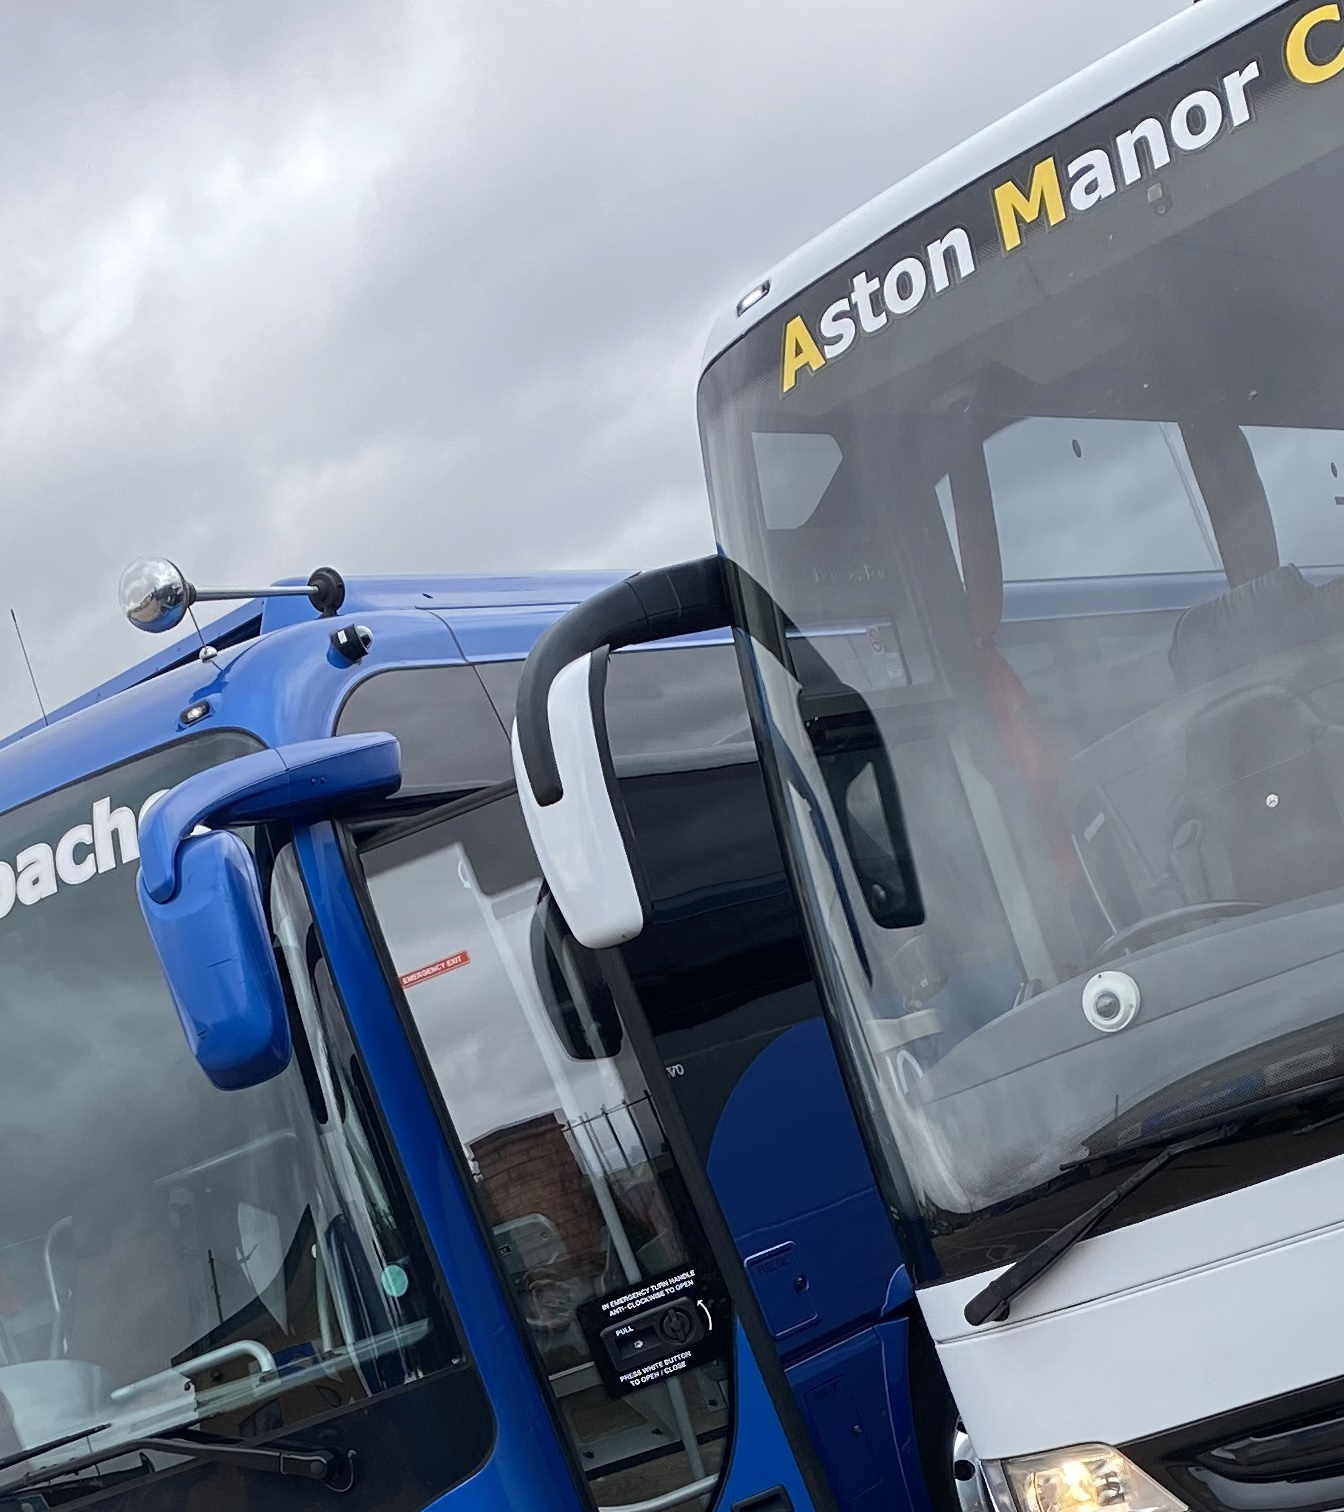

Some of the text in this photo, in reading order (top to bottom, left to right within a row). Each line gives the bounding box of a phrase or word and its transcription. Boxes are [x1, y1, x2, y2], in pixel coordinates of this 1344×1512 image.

[783, 224, 977, 393] Aston
[993, 60, 1260, 251] Manor
[609, 1287, 650, 1307] EMERGENCY
[650, 1279, 669, 1293] TURN
[668, 1269, 696, 1285] HANDLE
[666, 1286, 675, 1295] TO
[675, 1279, 694, 1291] OPEN
[615, 1325, 635, 1337] PULL
[619, 1350, 692, 1383] PRESS WHITE BUTTON
[629, 1378, 641, 1387] TO
[640, 1370, 660, 1383] OPEN
[663, 1360, 687, 1374] CLOSE
